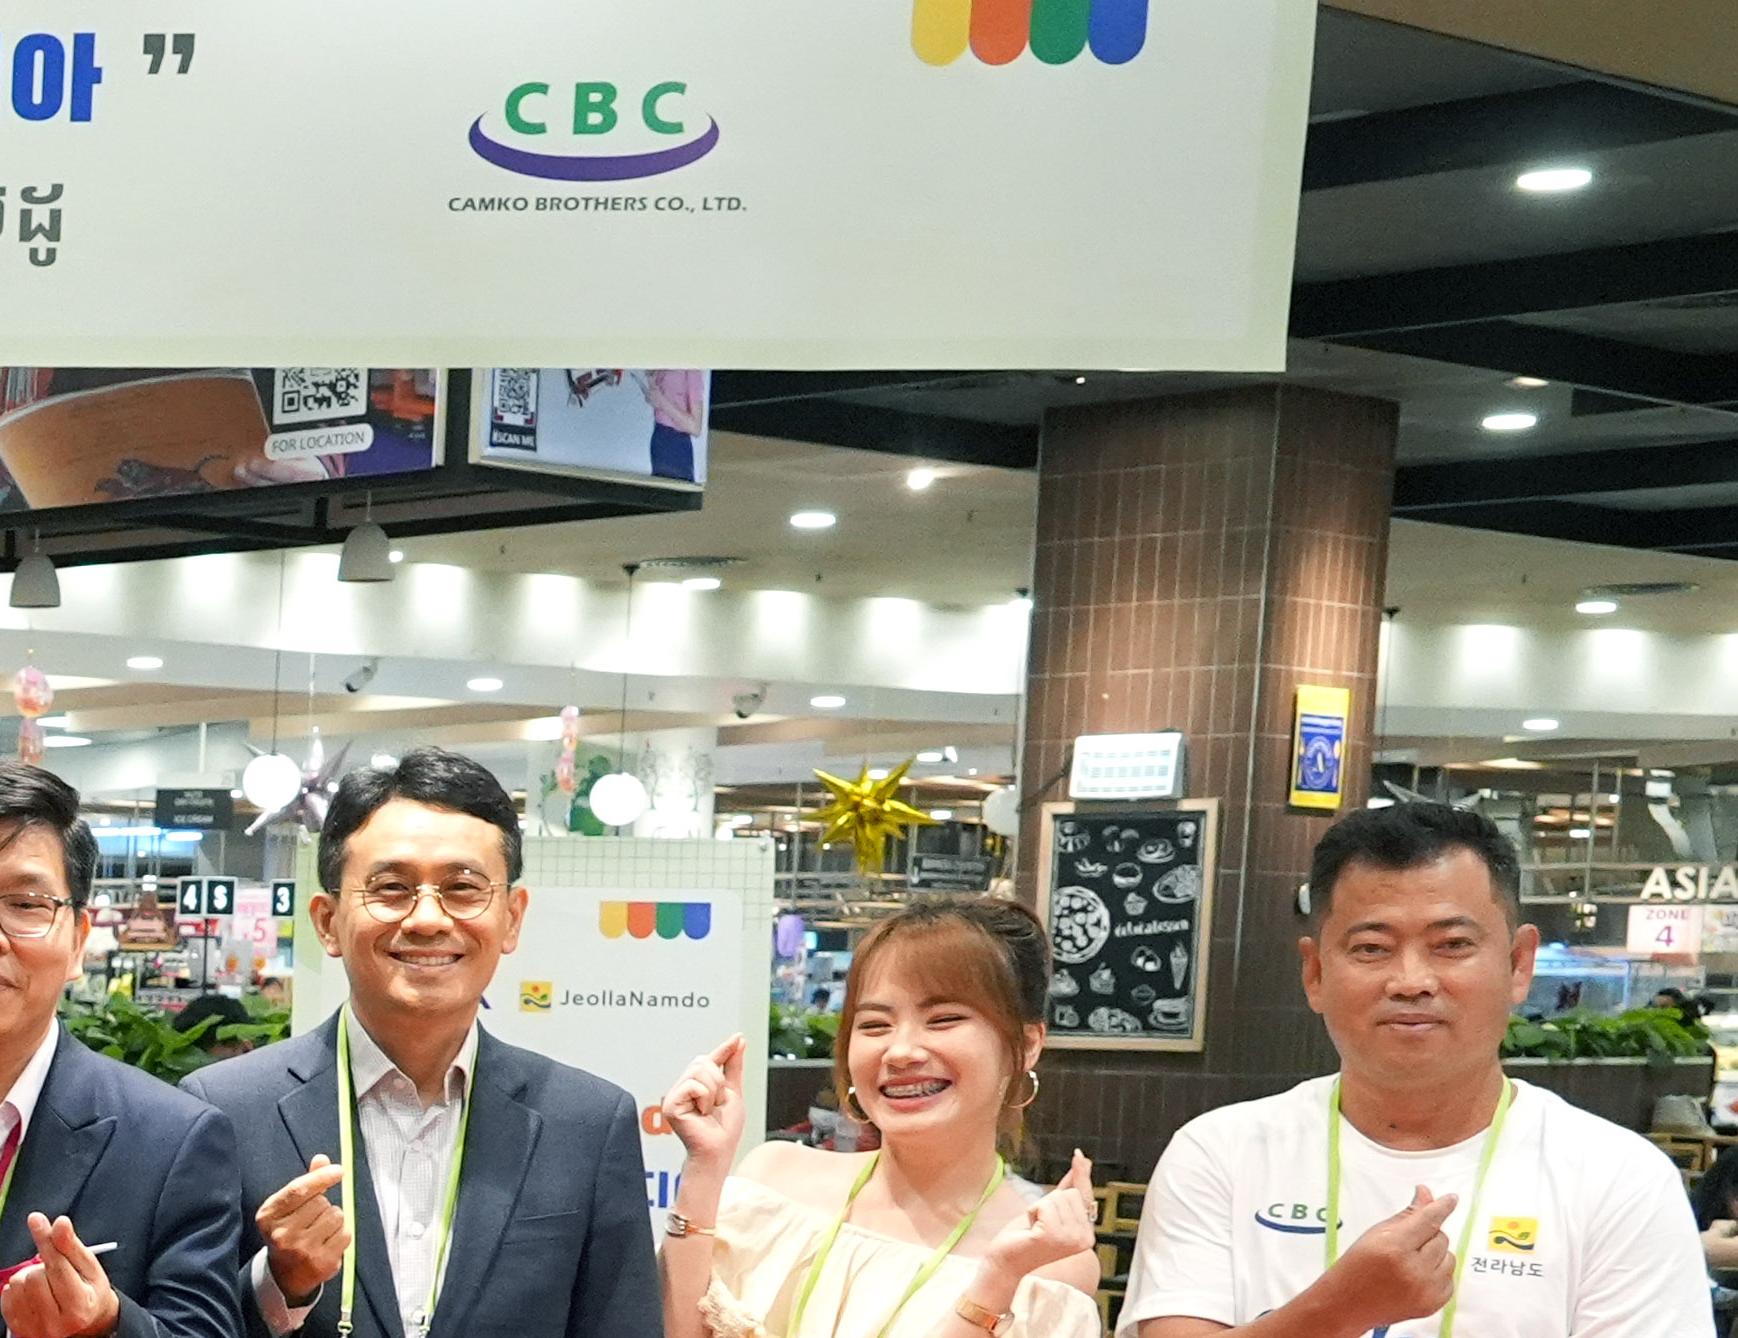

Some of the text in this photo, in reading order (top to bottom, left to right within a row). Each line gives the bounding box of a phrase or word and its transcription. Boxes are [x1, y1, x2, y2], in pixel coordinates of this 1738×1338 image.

[448, 196, 747, 213] CAMKO BROTHERS CO., LTD.
[273, 431, 365, 453] FOR LOCATION
[182, 884, 198, 911] 4
[276, 886, 291, 913] 3
[1646, 908, 1690, 921] ZONE
[1654, 924, 1674, 948] 4
[560, 989, 711, 1009] JeollaNamdo
[1470, 1257, 1544, 1278] 전라남도
